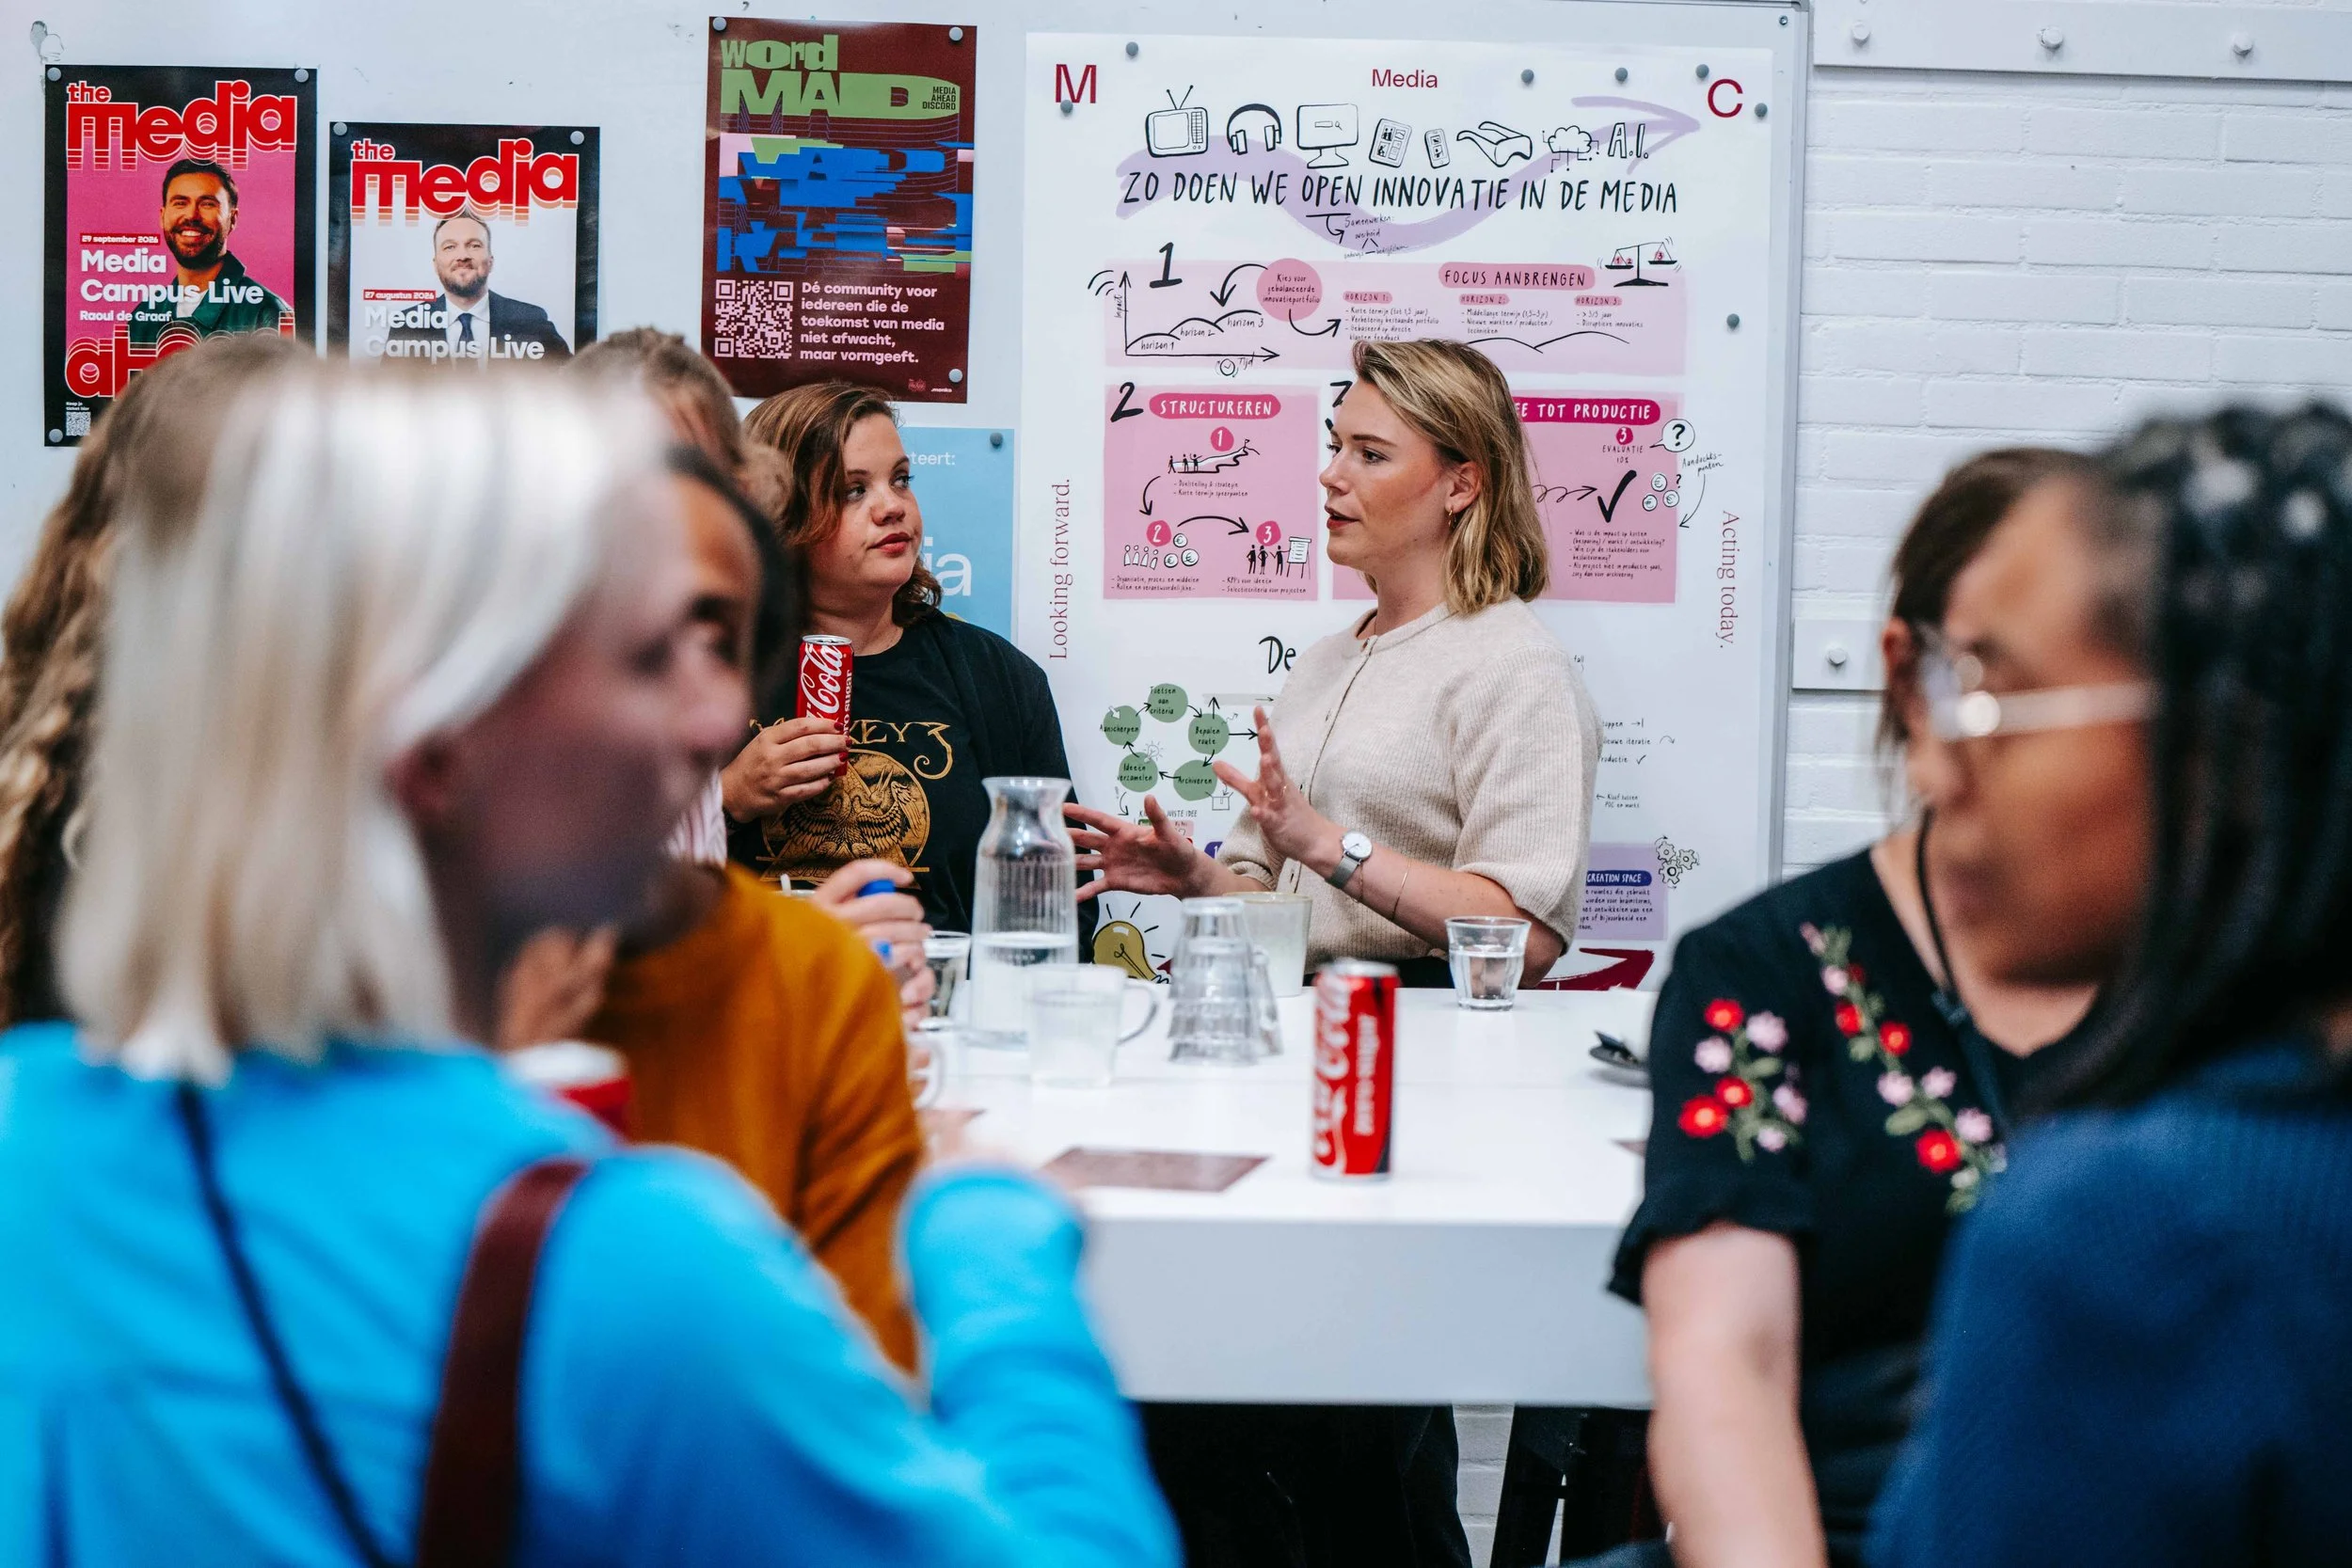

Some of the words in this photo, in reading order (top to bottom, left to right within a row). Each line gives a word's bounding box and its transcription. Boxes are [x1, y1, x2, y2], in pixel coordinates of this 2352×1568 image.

[1055, 64, 1097, 103] M
[1372, 68, 1438, 88] Media
[68, 81, 111, 103] the
[720, 69, 961, 120] MAD
[932, 86, 957, 94] MEDIA
[1707, 78, 1743, 119] C
[922, 102, 956, 110] DISCORD
[66, 80, 297, 166] media
[352, 139, 395, 160] the
[1607, 122, 1649, 159] A.I.
[350, 138, 580, 220] media
[1123, 171, 1159, 204] ZO
[1173, 171, 1238, 204] DOEN
[1251, 170, 1288, 205] WE
[1301, 174, 1363, 207] OPEN
[1373, 175, 1510, 211] INNOVATIE
[1519, 179, 1546, 211] IN
[1560, 179, 1589, 211] DE
[1599, 179, 1677, 214] MEDIA
[92, 235, 136, 244] september
[81, 247, 167, 273] Media
[1149, 241, 1183, 289] 1
[1444, 270, 1486, 285] FOCUS
[1495, 271, 1585, 287] AANBRENGEN
[80, 278, 201, 309] Campus
[208, 278, 263, 304] Live
[375, 292, 412, 300] augustus
[802, 281, 820, 293] Dé
[824, 283, 902, 299] community
[906, 287, 938, 297] voor
[1267, 285, 1315, 294] gebalanceerde
[1345, 293, 1377, 301] HORIZON
[801, 297, 863, 311] iedereen
[866, 299, 887, 312] die
[891, 301, 909, 313] de
[1576, 297, 1609, 306] HORIZON
[80, 310, 114, 322] Raoul
[117, 310, 133, 322] de
[135, 310, 172, 322] Graaf
[365, 304, 449, 328] Media
[801, 315, 869, 328] toekomst
[873, 319, 898, 329] van
[901, 318, 945, 331] media
[1227, 317, 1255, 327] horizon
[1259, 318, 1263, 327] 3
[801, 331, 828, 343] niet
[832, 332, 896, 348] afwacht,
[1180, 328, 1205, 337] horizon
[365, 335, 483, 365] Campus
[490, 334, 545, 359] Live
[1141, 340, 1168, 350] horizon
[800, 350, 836, 360] maar
[840, 351, 919, 365] vormgeeft.
[1110, 381, 1144, 423] 2
[1160, 400, 1272, 416] STRUCTUREREN
[1537, 404, 1566, 419] TOT
[1574, 404, 1651, 420] PRODUCTIE
[1216, 429, 1224, 447] 1
[1619, 427, 1627, 442] 3
[1602, 445, 1644, 453] EVALUATIE
[907, 451, 956, 466] teert:
[1050, 479, 1071, 565] forward.
[1152, 524, 1162, 543] 2
[1263, 524, 1272, 543] 3
[1717, 510, 1740, 579] Acting
[1050, 573, 1073, 659] Looking
[1715, 585, 1739, 648] today.
[1259, 636, 1296, 674] De
[801, 642, 843, 714] Cola
[1150, 686, 1176, 694] Toetsen
[1100, 724, 1139, 734] Aanscherpen
[1195, 725, 1220, 735] Bepalen
[1600, 754, 1628, 763] roductie
[1587, 873, 1620, 883] CREATION
[1622, 873, 1642, 883] SPACE
